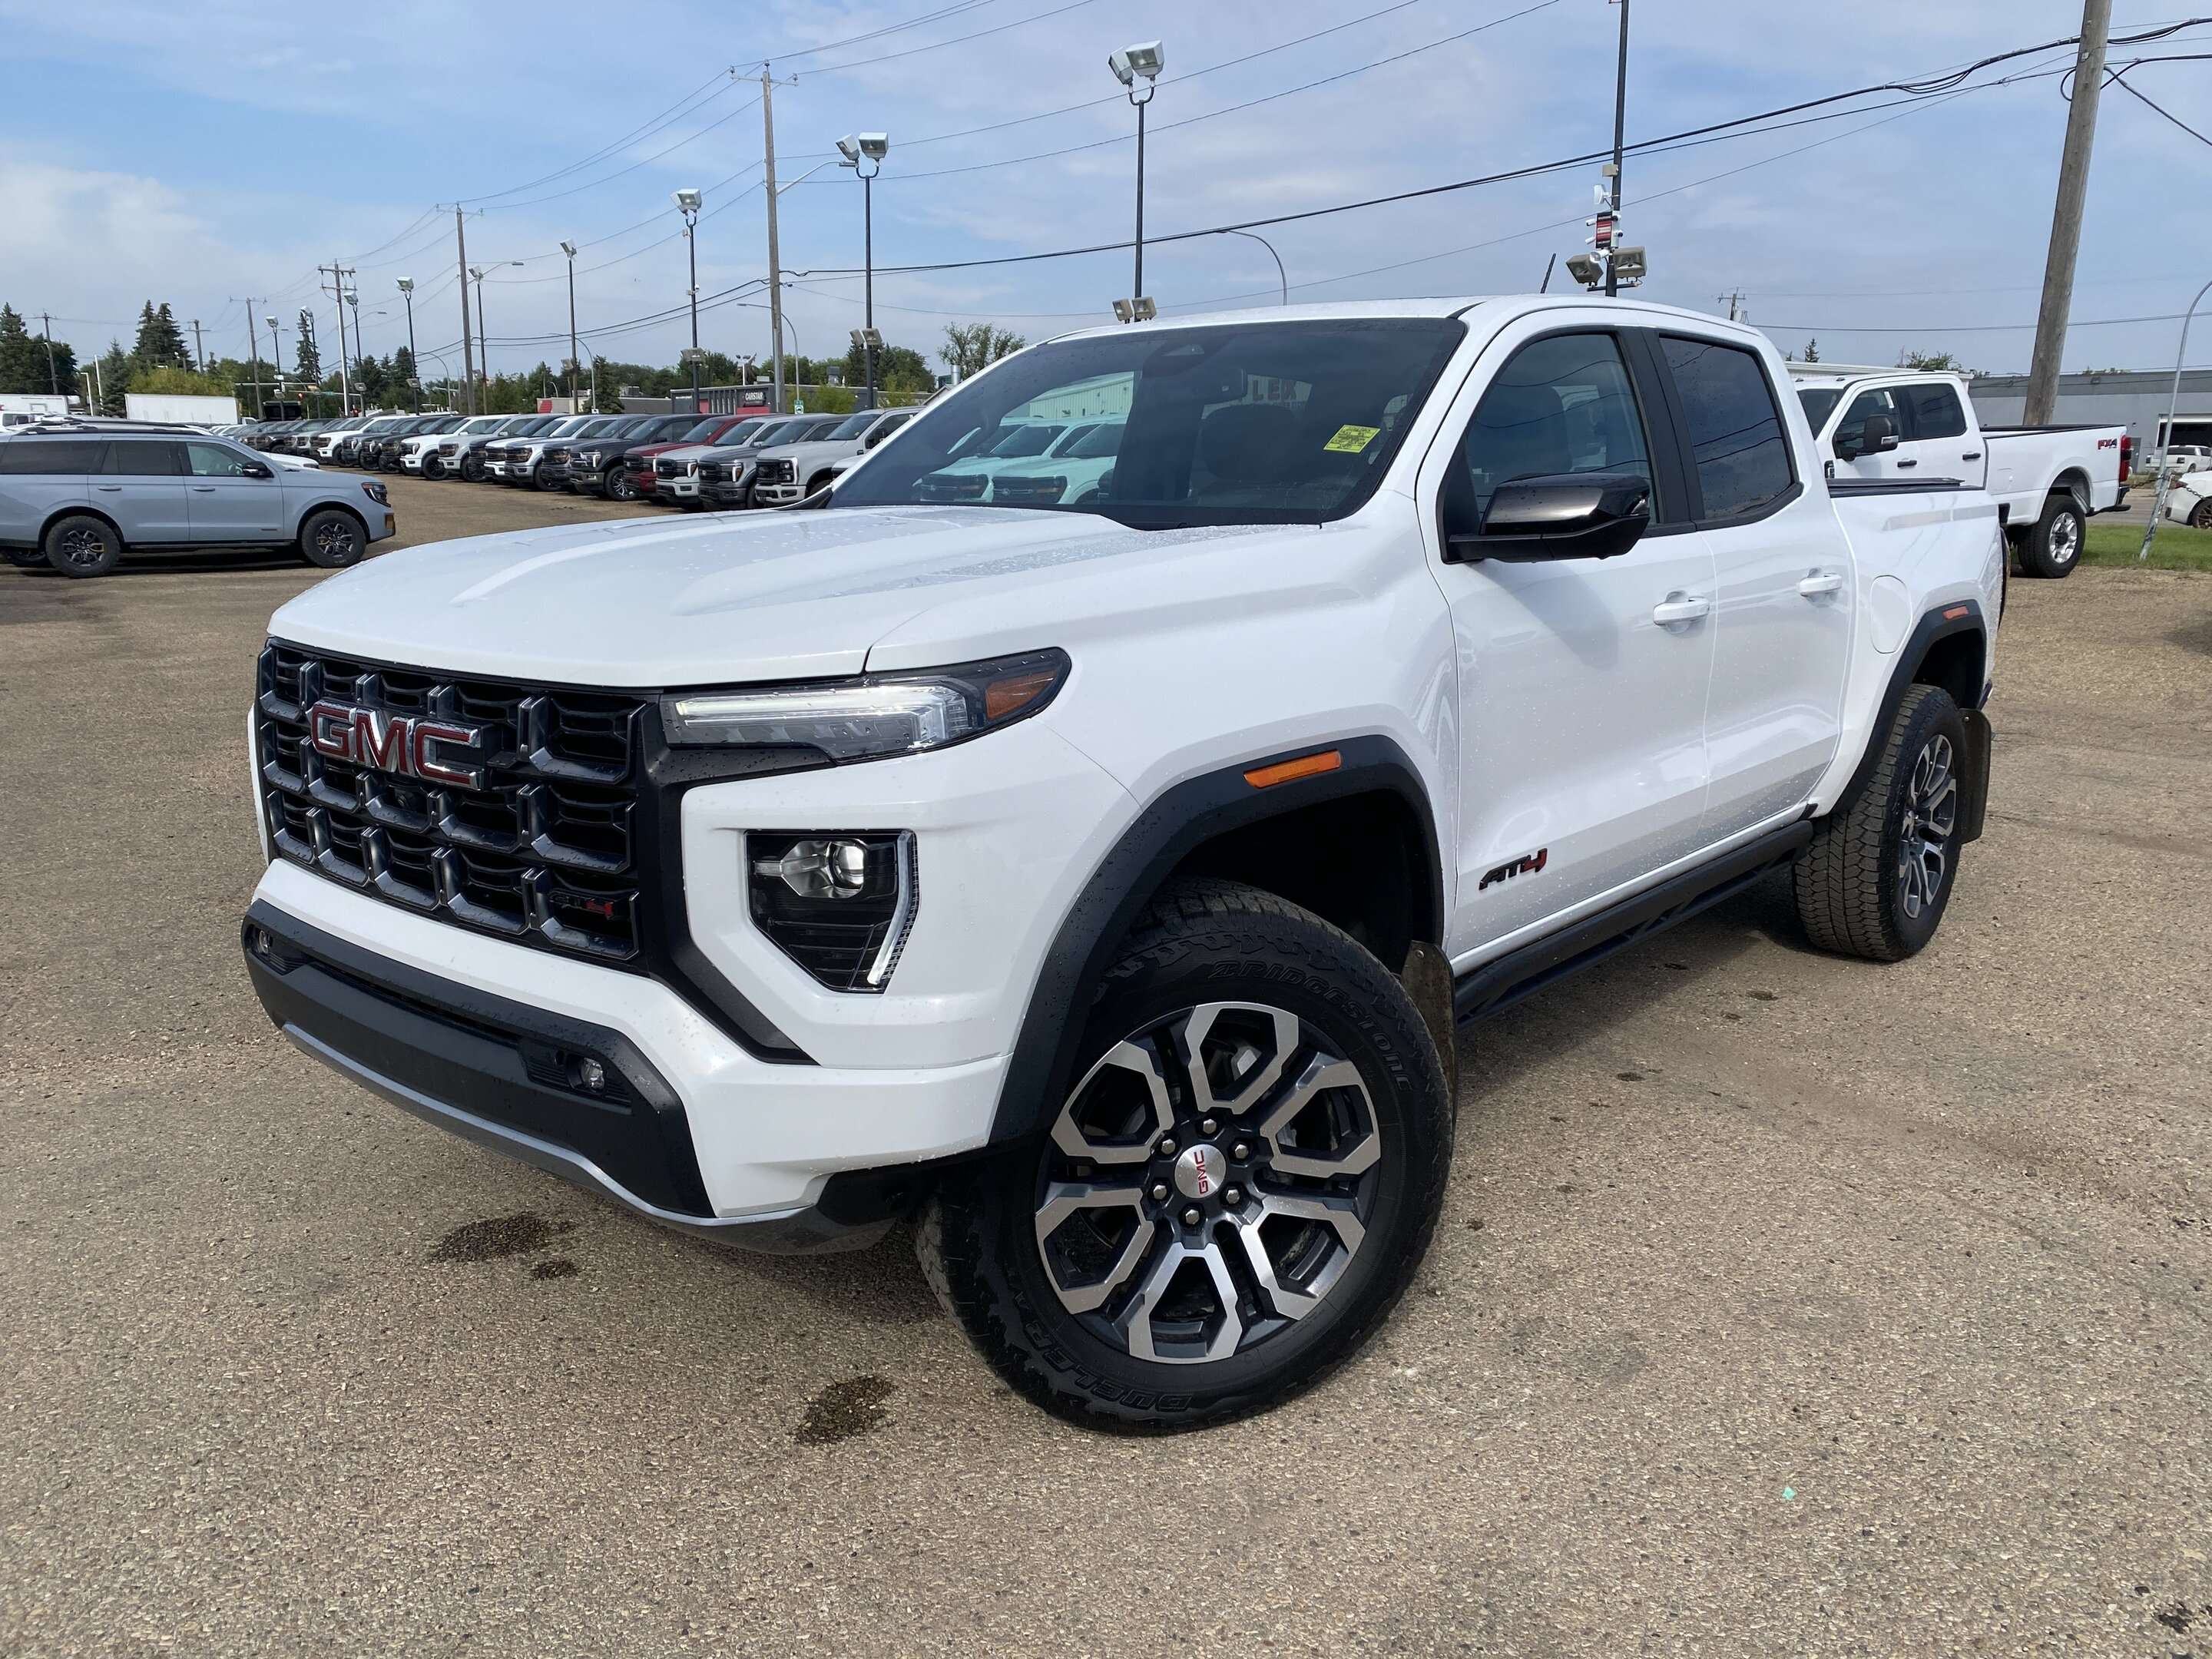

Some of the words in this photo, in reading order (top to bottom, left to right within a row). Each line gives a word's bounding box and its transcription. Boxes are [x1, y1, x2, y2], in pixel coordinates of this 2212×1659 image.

[745, 392, 763, 400] CARSTAR
[2098, 438, 2118, 450] FX4
[311, 700, 484, 790] GMC
[1479, 848, 1548, 890] AT4
[1207, 960, 1415, 1093] BRIDGESTONE
[1194, 1150, 1209, 1194] GMC
[1023, 1318, 1193, 1412] DUELER
